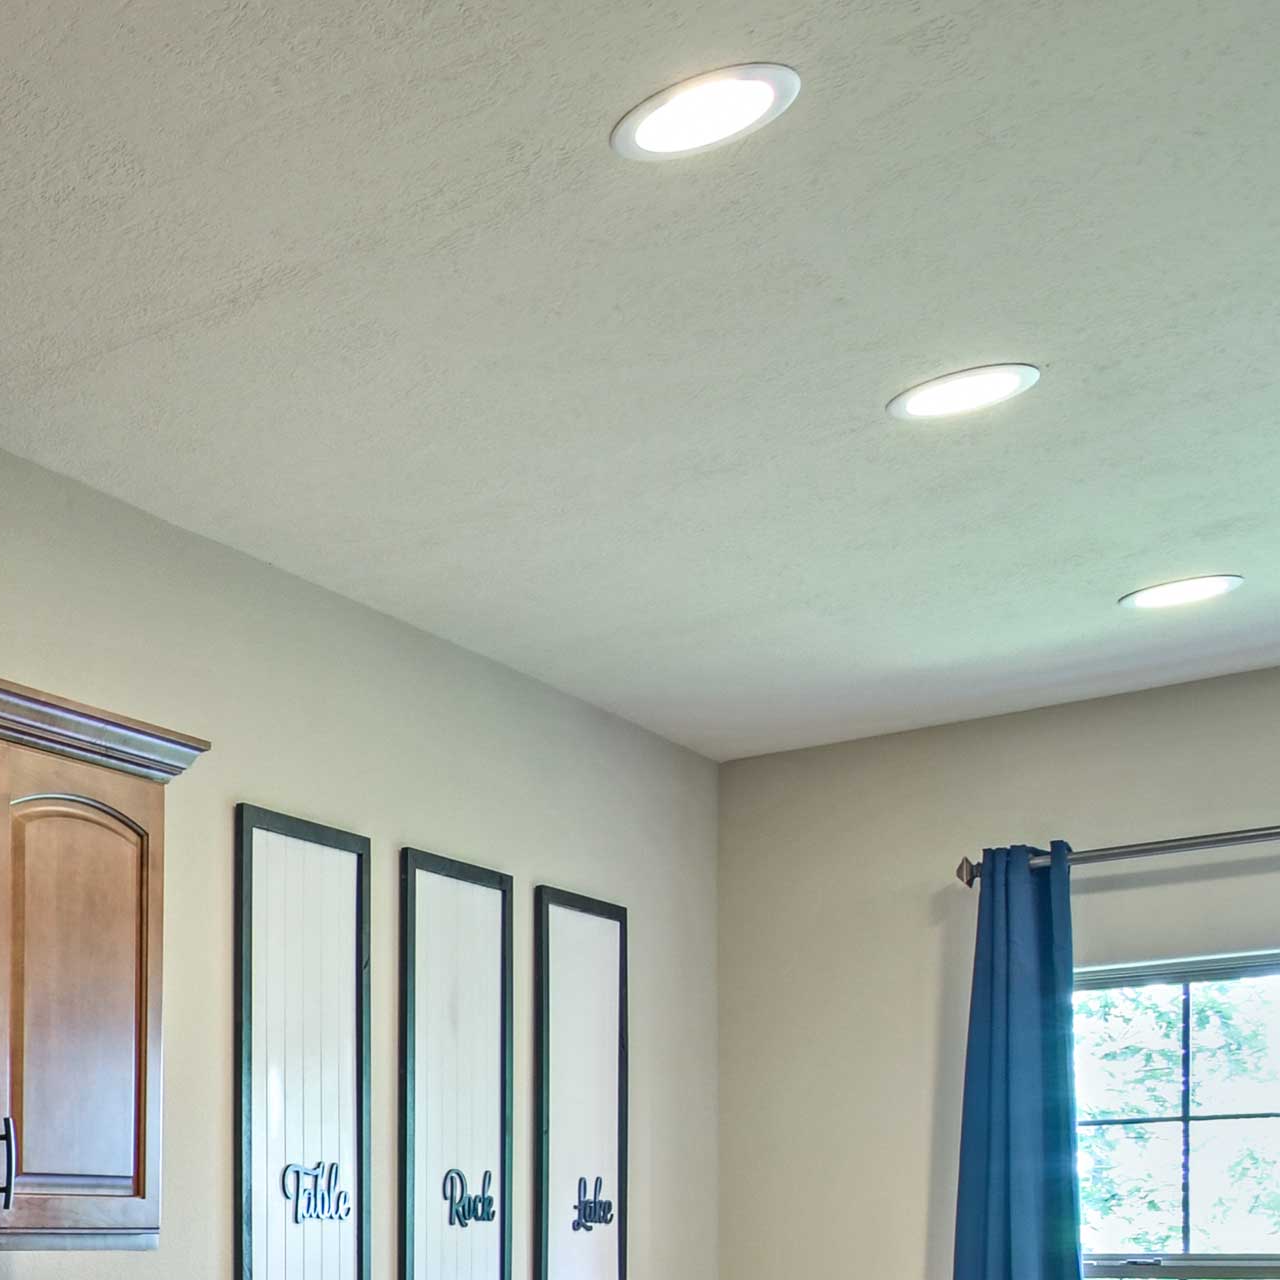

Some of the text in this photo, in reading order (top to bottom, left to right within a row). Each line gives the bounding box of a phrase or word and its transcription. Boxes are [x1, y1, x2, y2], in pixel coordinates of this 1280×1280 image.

[281, 1161, 351, 1225] Table
[441, 1168, 496, 1228] Rock
[571, 1176, 614, 1232] Lake
